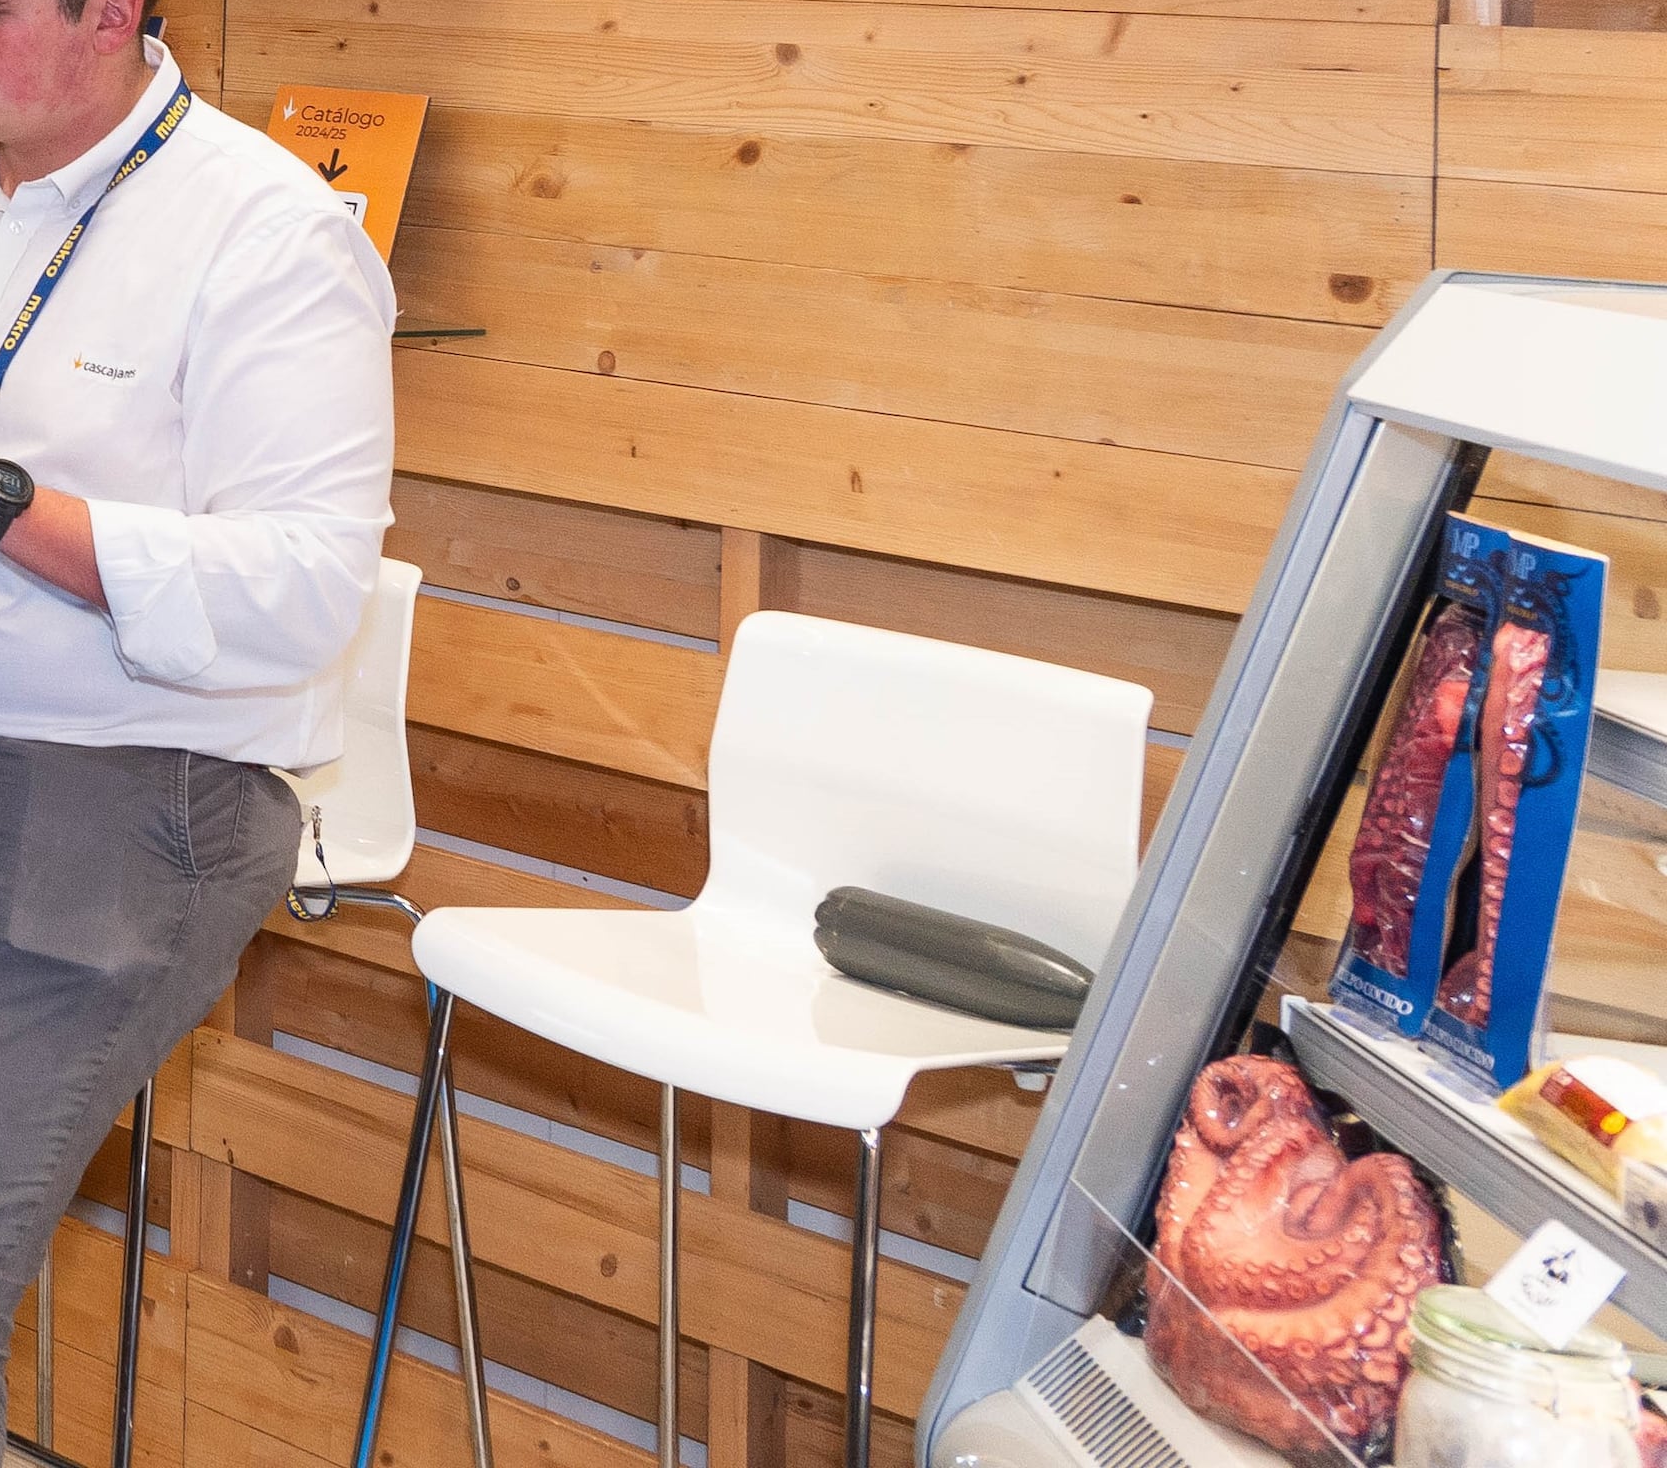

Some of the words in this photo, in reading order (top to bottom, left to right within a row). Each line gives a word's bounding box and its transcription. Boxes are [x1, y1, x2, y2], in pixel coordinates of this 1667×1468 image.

[155, 94, 190, 140] makro
[295, 125, 347, 140] 2024/25
[301, 105, 386, 129] Catálogo
[45, 224, 83, 278] makro
[3, 294, 42, 351] makro
